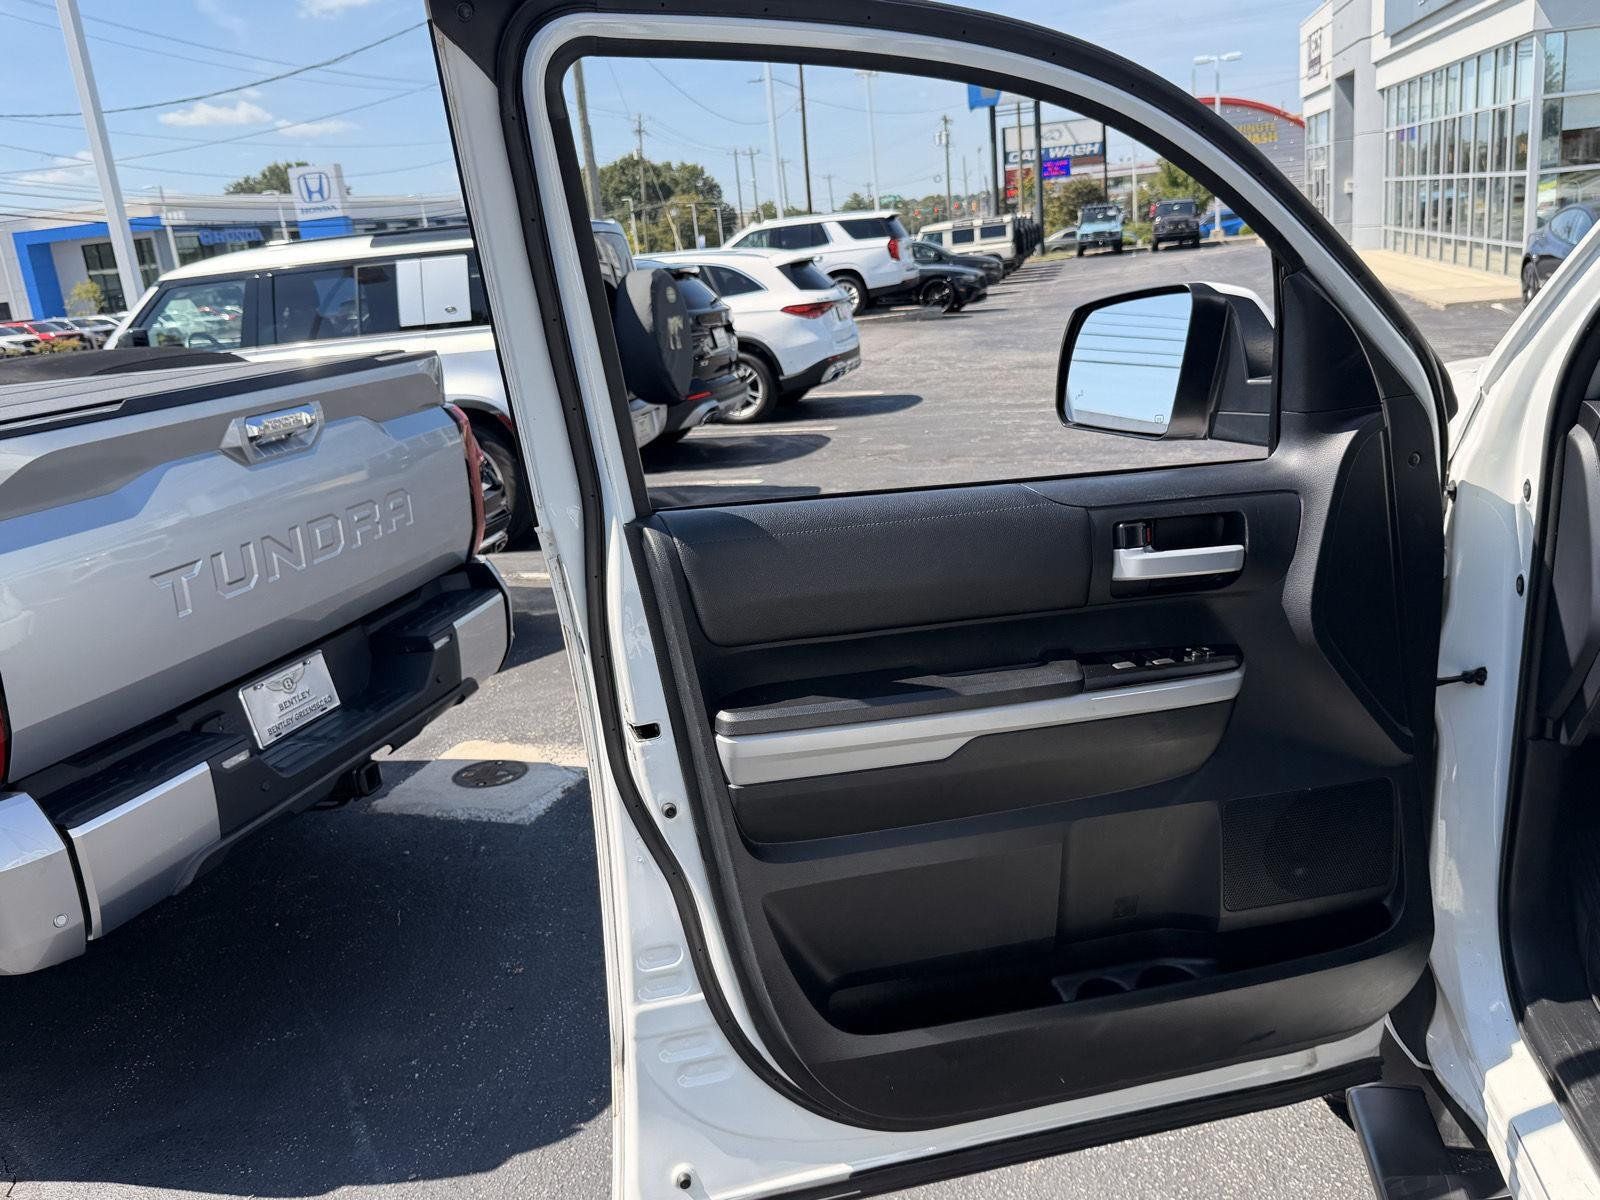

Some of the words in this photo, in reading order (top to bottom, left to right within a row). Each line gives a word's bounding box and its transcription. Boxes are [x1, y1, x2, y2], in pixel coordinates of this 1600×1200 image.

[1048, 143, 1100, 159] WASH
[150, 487, 415, 619] TUNDRA
[278, 688, 311, 712] BENTLEY
[267, 716, 294, 736] BENTLEY
